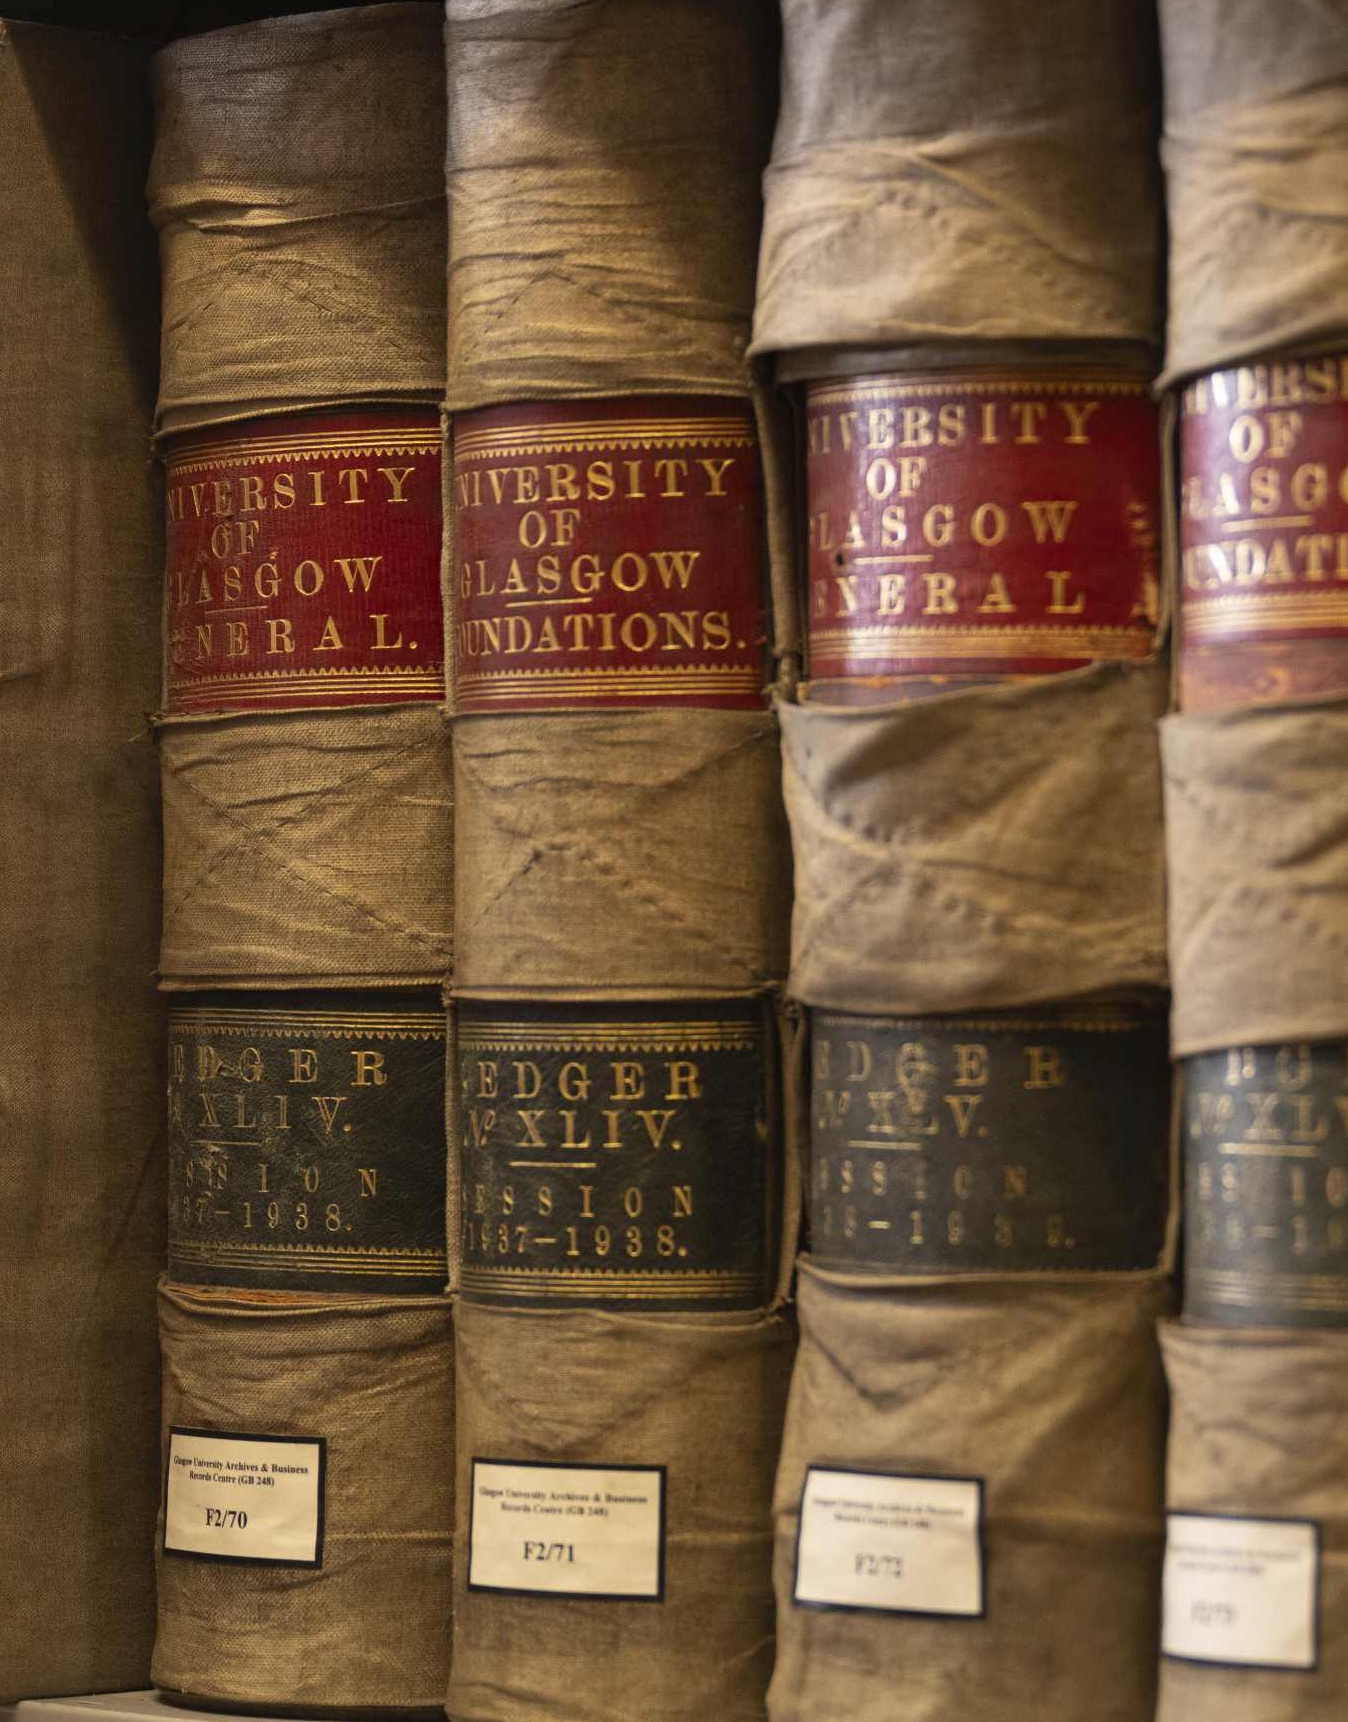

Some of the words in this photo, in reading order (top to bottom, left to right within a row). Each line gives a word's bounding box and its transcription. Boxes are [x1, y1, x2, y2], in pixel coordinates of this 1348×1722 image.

[1228, 411, 1302, 464] OF
[865, 455, 927, 501] OF
[211, 520, 260, 559] OF
[519, 508, 581, 549] OF
[810, 500, 1078, 550] LASGOW
[167, 555, 383, 606] LASGOW
[461, 551, 700, 600] GLASGOW
[199, 1092, 353, 1135] XLIV.
[516, 1109, 683, 1150] XLIV.
[212, 1473, 236, 1483] Centre
[238, 1476, 254, 1487] (GB
[225, 1461, 258, 1472] Archives
[260, 1463, 269, 1473] &
[271, 1464, 309, 1475] Business
[205, 1508, 248, 1530] F2/70
[523, 1541, 575, 1562] F2/71
